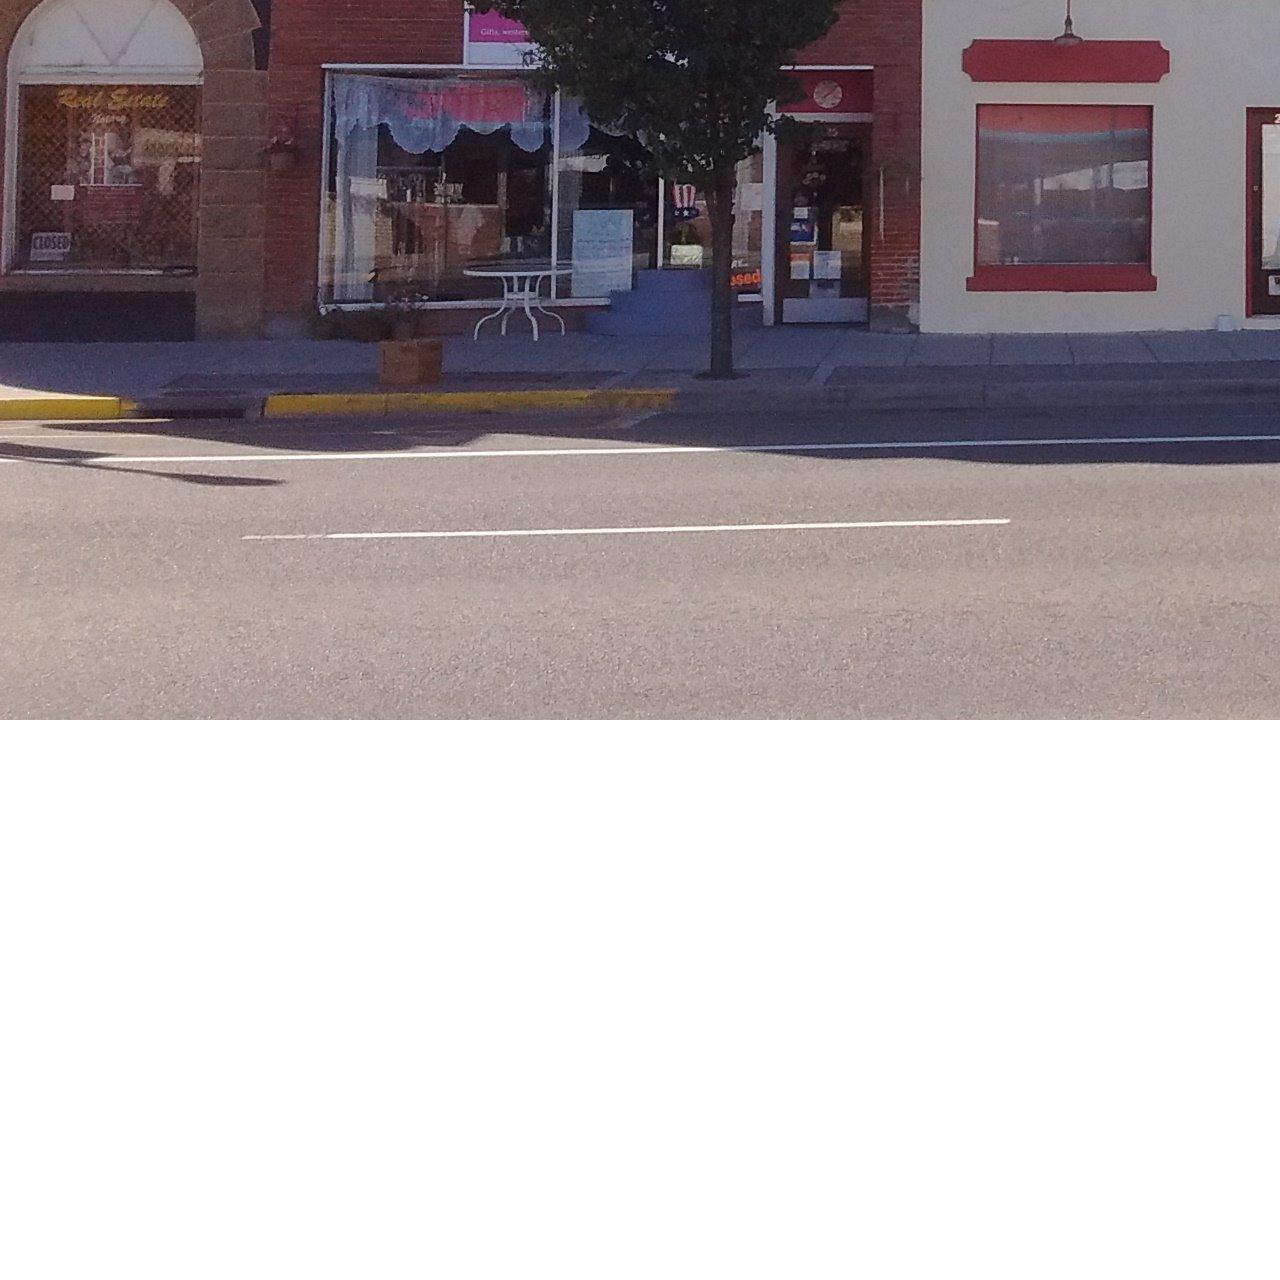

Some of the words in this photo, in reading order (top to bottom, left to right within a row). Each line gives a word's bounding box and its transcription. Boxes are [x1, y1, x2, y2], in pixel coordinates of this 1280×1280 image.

[59, 86, 103, 108] Real
[107, 86, 169, 110] Estate
[33, 235, 69, 250] CLOSED
